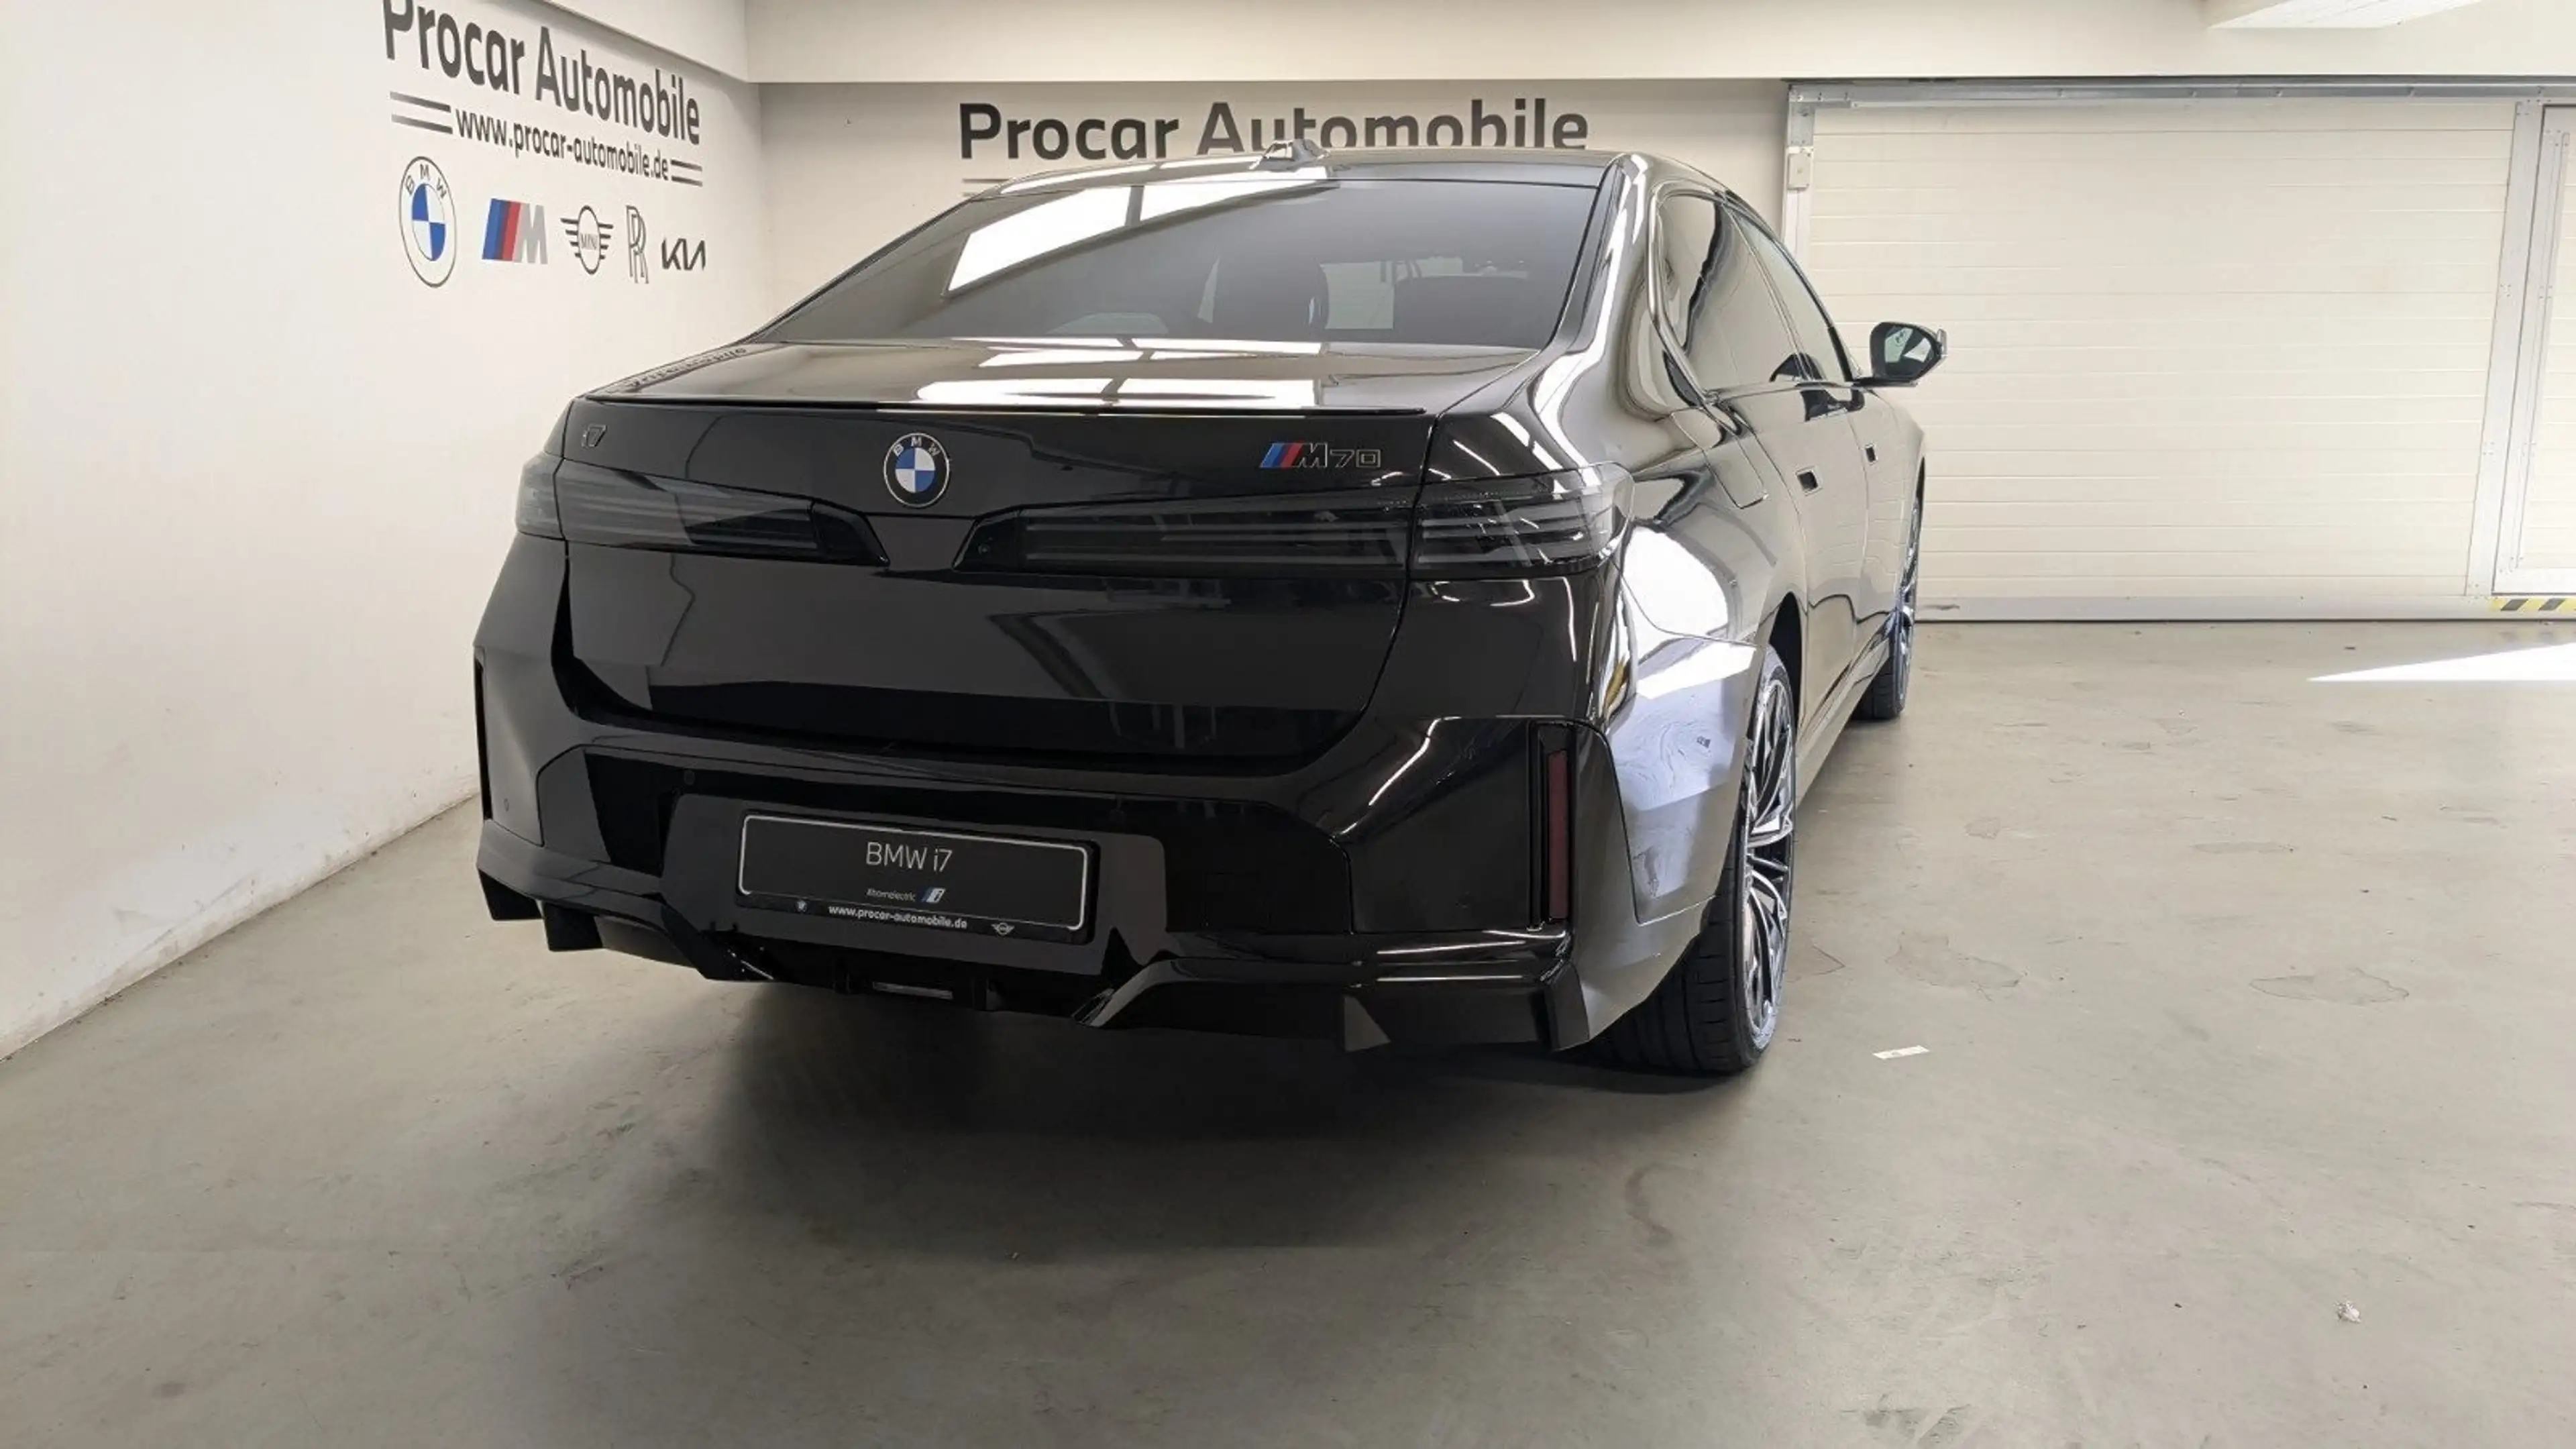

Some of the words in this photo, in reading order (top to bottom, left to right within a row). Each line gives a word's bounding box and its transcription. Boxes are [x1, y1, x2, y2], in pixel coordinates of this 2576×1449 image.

[382, 0, 525, 95] Procar
[536, 26, 700, 144] Automobile
[455, 108, 669, 181] www.procar-automobile.de
[961, 103, 1179, 160] Procar
[1197, 99, 1589, 154] Automobile
[405, 164, 447, 199] BMW
[893, 436, 941, 457] BMW
[865, 842, 927, 870] BMW
[933, 848, 953, 872] i7
[828, 906, 967, 929] www.procar-automobile.de
